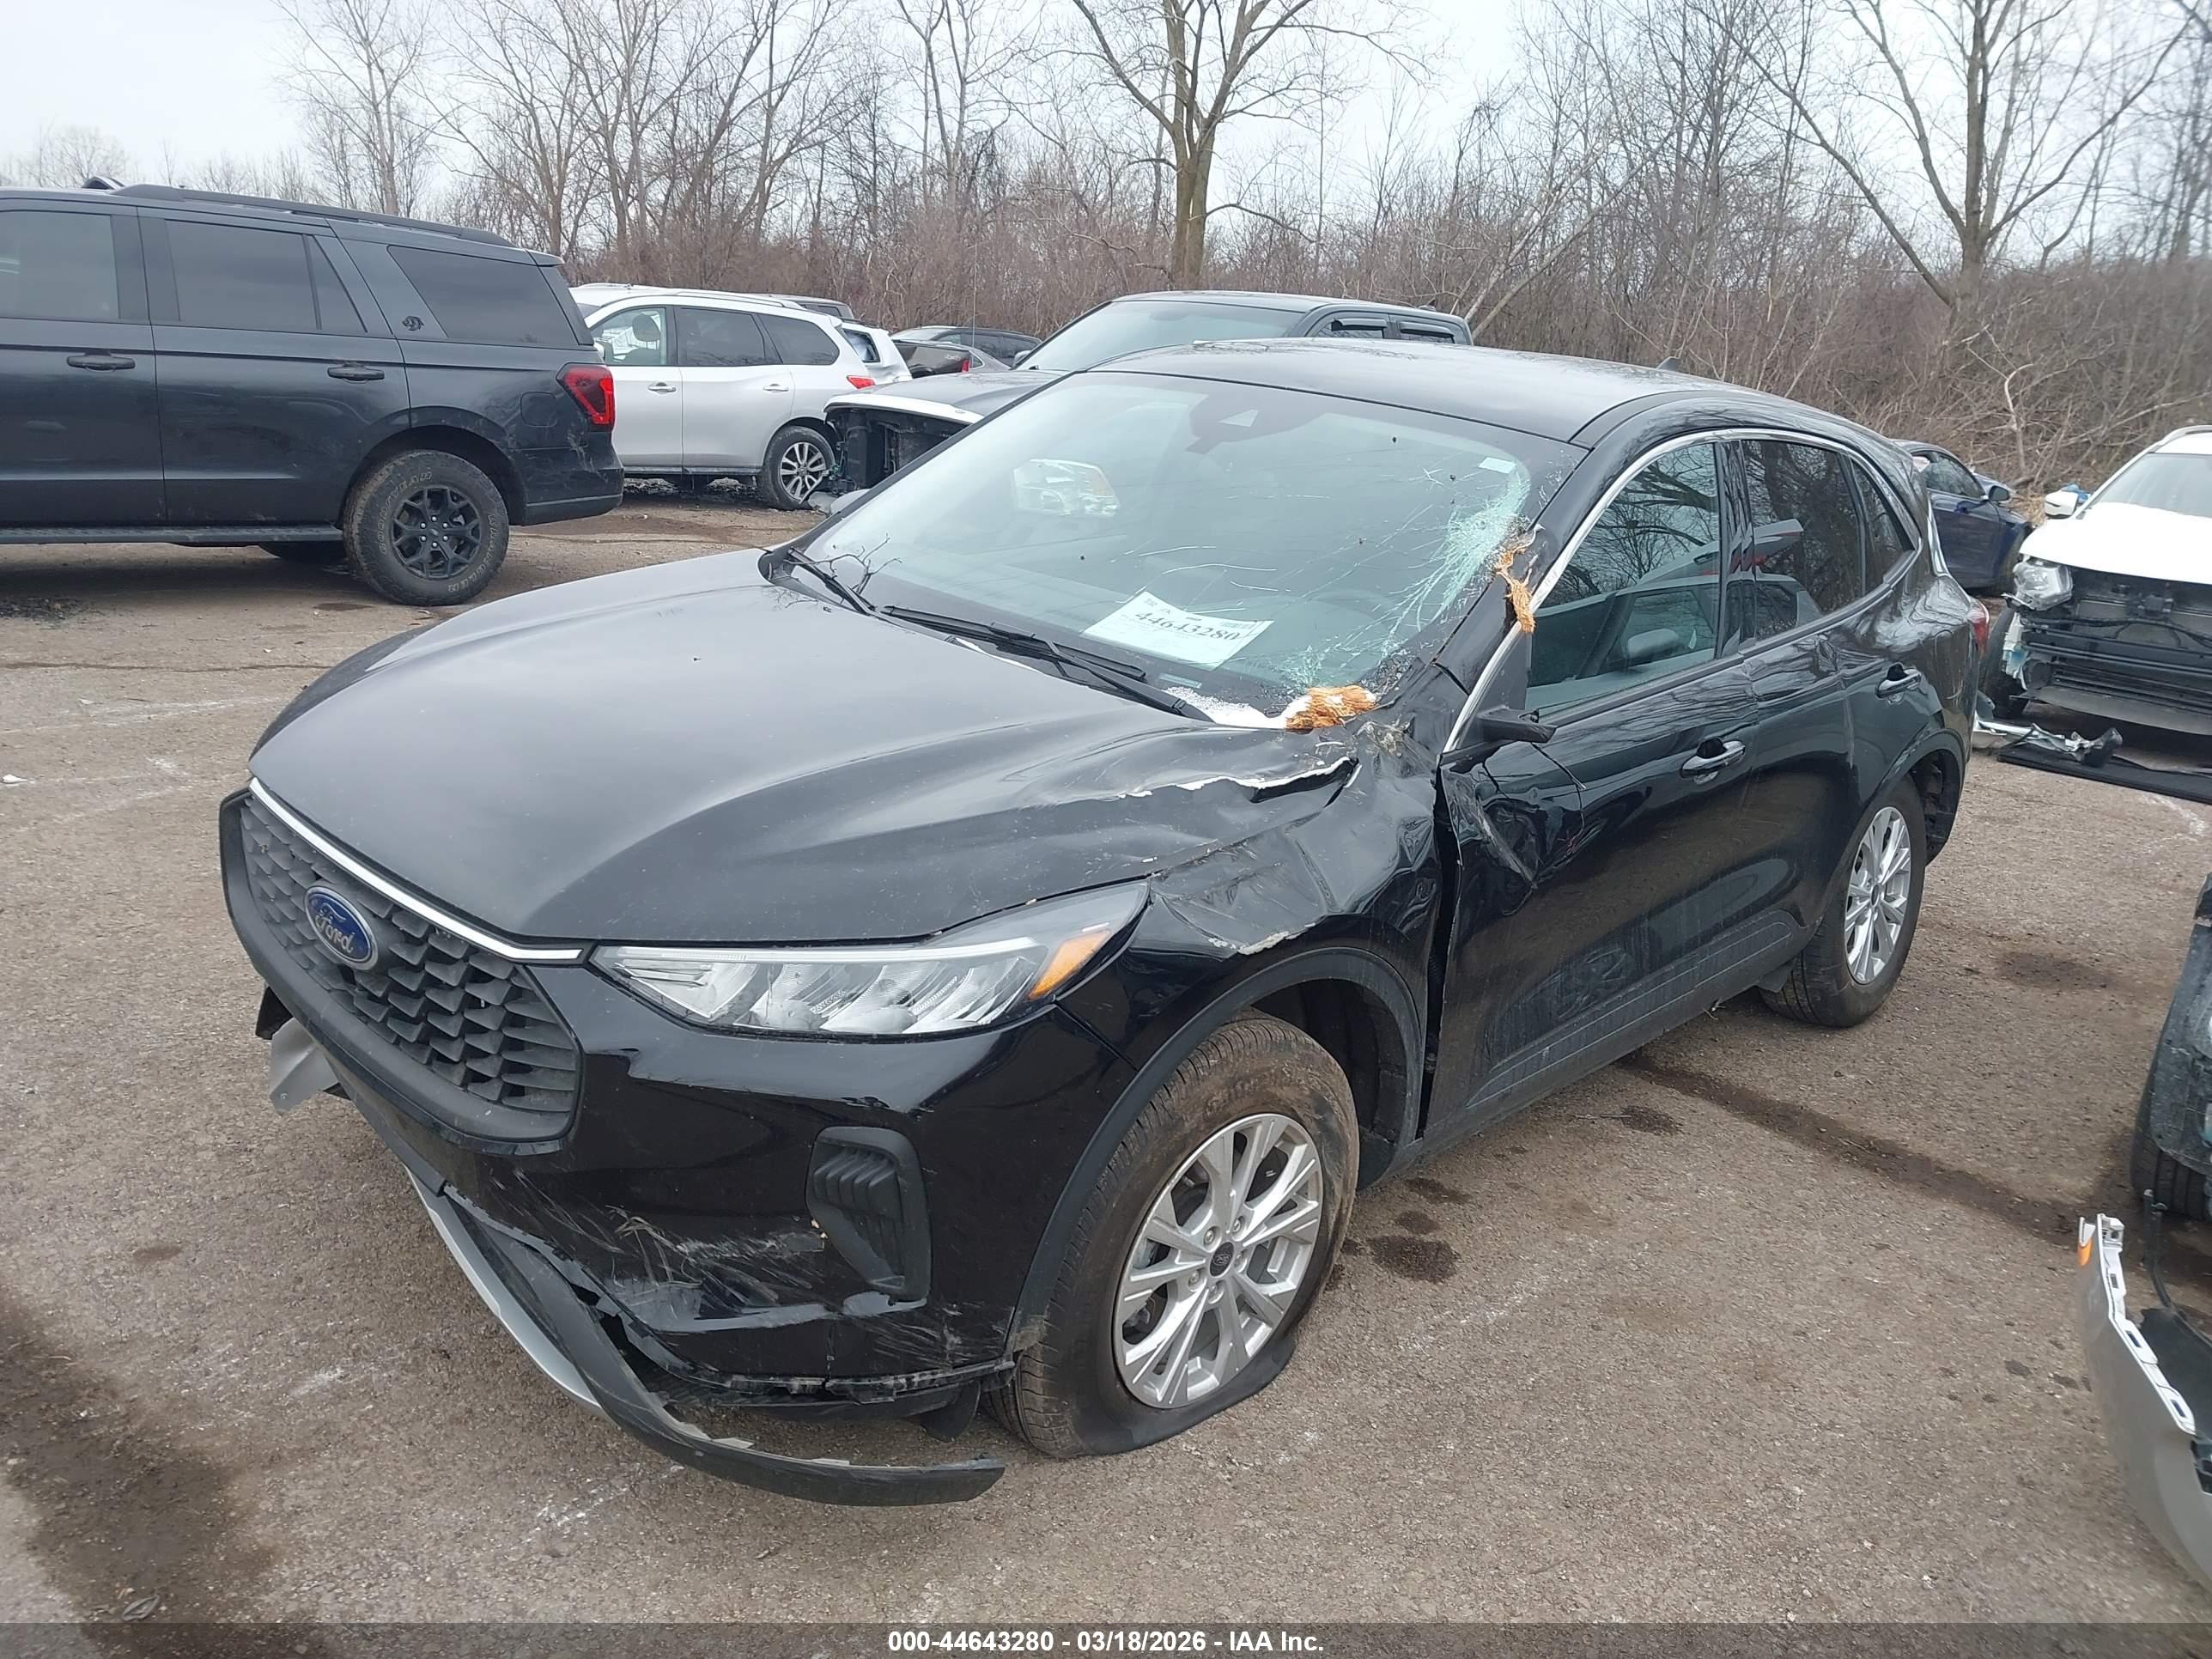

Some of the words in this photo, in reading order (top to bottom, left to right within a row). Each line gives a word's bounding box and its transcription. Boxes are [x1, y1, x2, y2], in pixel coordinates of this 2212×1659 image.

[377, 471, 433, 555] GOODYEAR
[1135, 612, 1240, 641] 44643280
[315, 902, 356, 953] Ford
